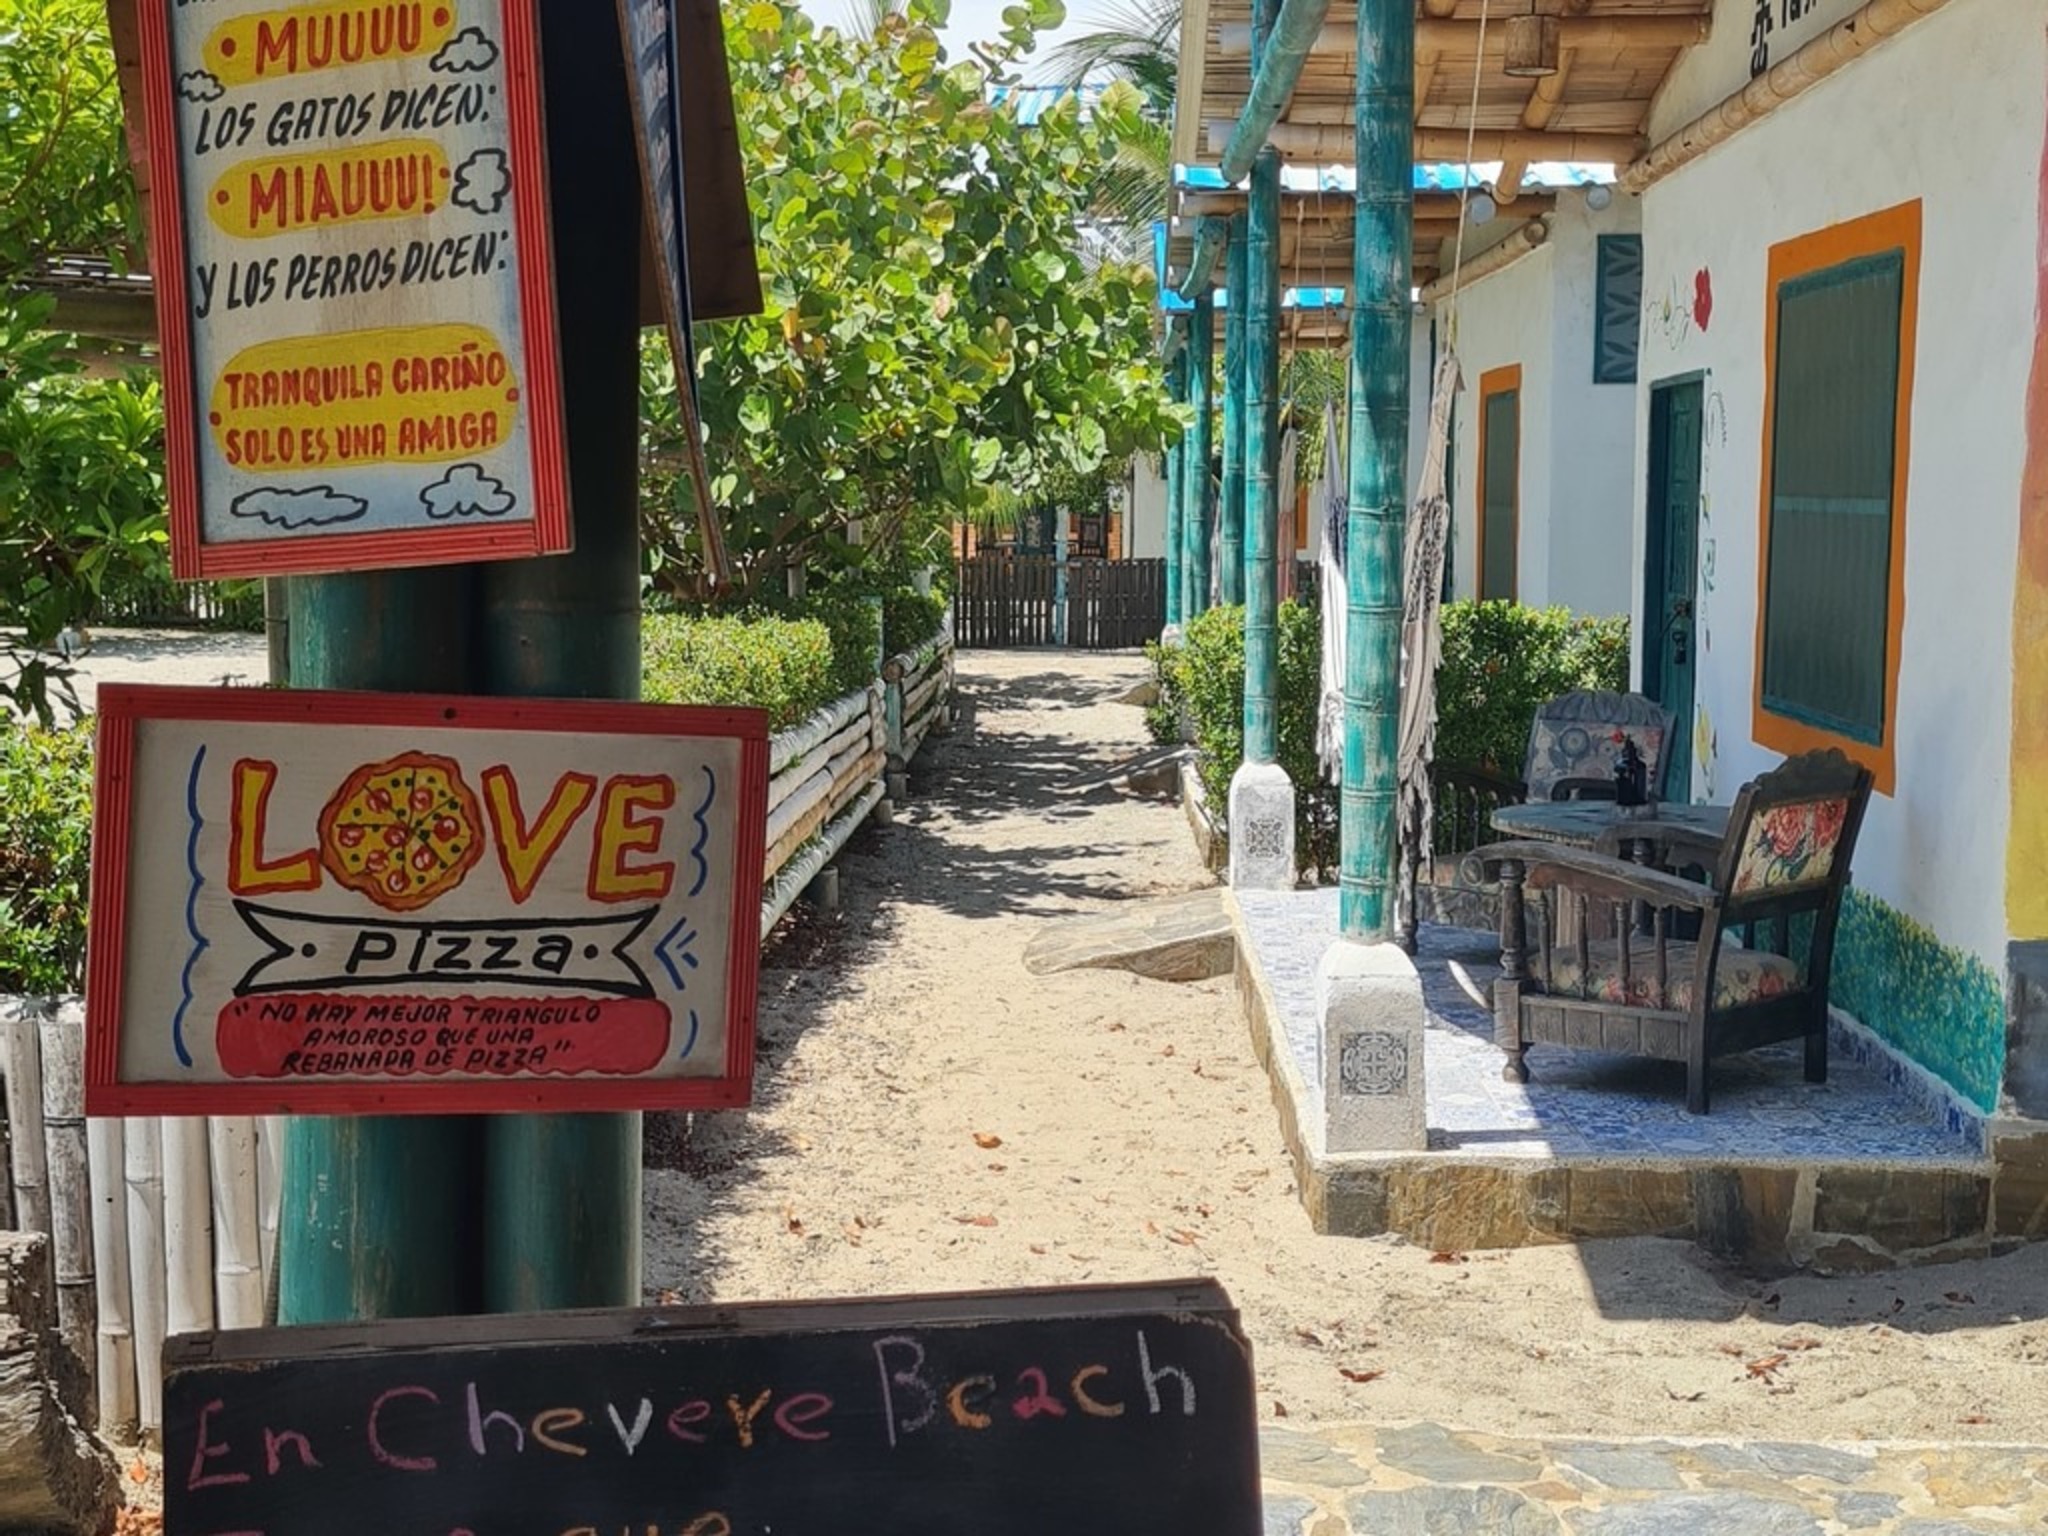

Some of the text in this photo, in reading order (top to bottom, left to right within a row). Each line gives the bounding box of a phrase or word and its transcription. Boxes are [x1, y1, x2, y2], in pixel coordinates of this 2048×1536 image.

[255, 2, 422, 76] MUUUU
[195, 82, 497, 155] LOS GATOS DICEN:
[249, 153, 436, 229] MIAUUU!
[226, 257, 279, 310] LOS
[285, 247, 397, 301] PERROS
[400, 230, 509, 286] DICEN:
[223, 342, 507, 411] TRANQUILA CARIÑO
[225, 410, 498, 466] SOLO ES UNA AMIGA
[302, 1027, 535, 1048] AMOROSO QUE UNA
[305, 1002, 358, 1025] HAY
[364, 1004, 452, 1023] MEJOR
[463, 1004, 601, 1025] TRIANGULO
[281, 1049, 415, 1073] REBANADA
[425, 1049, 457, 1067] DE
[187, 1399, 323, 1491] En
